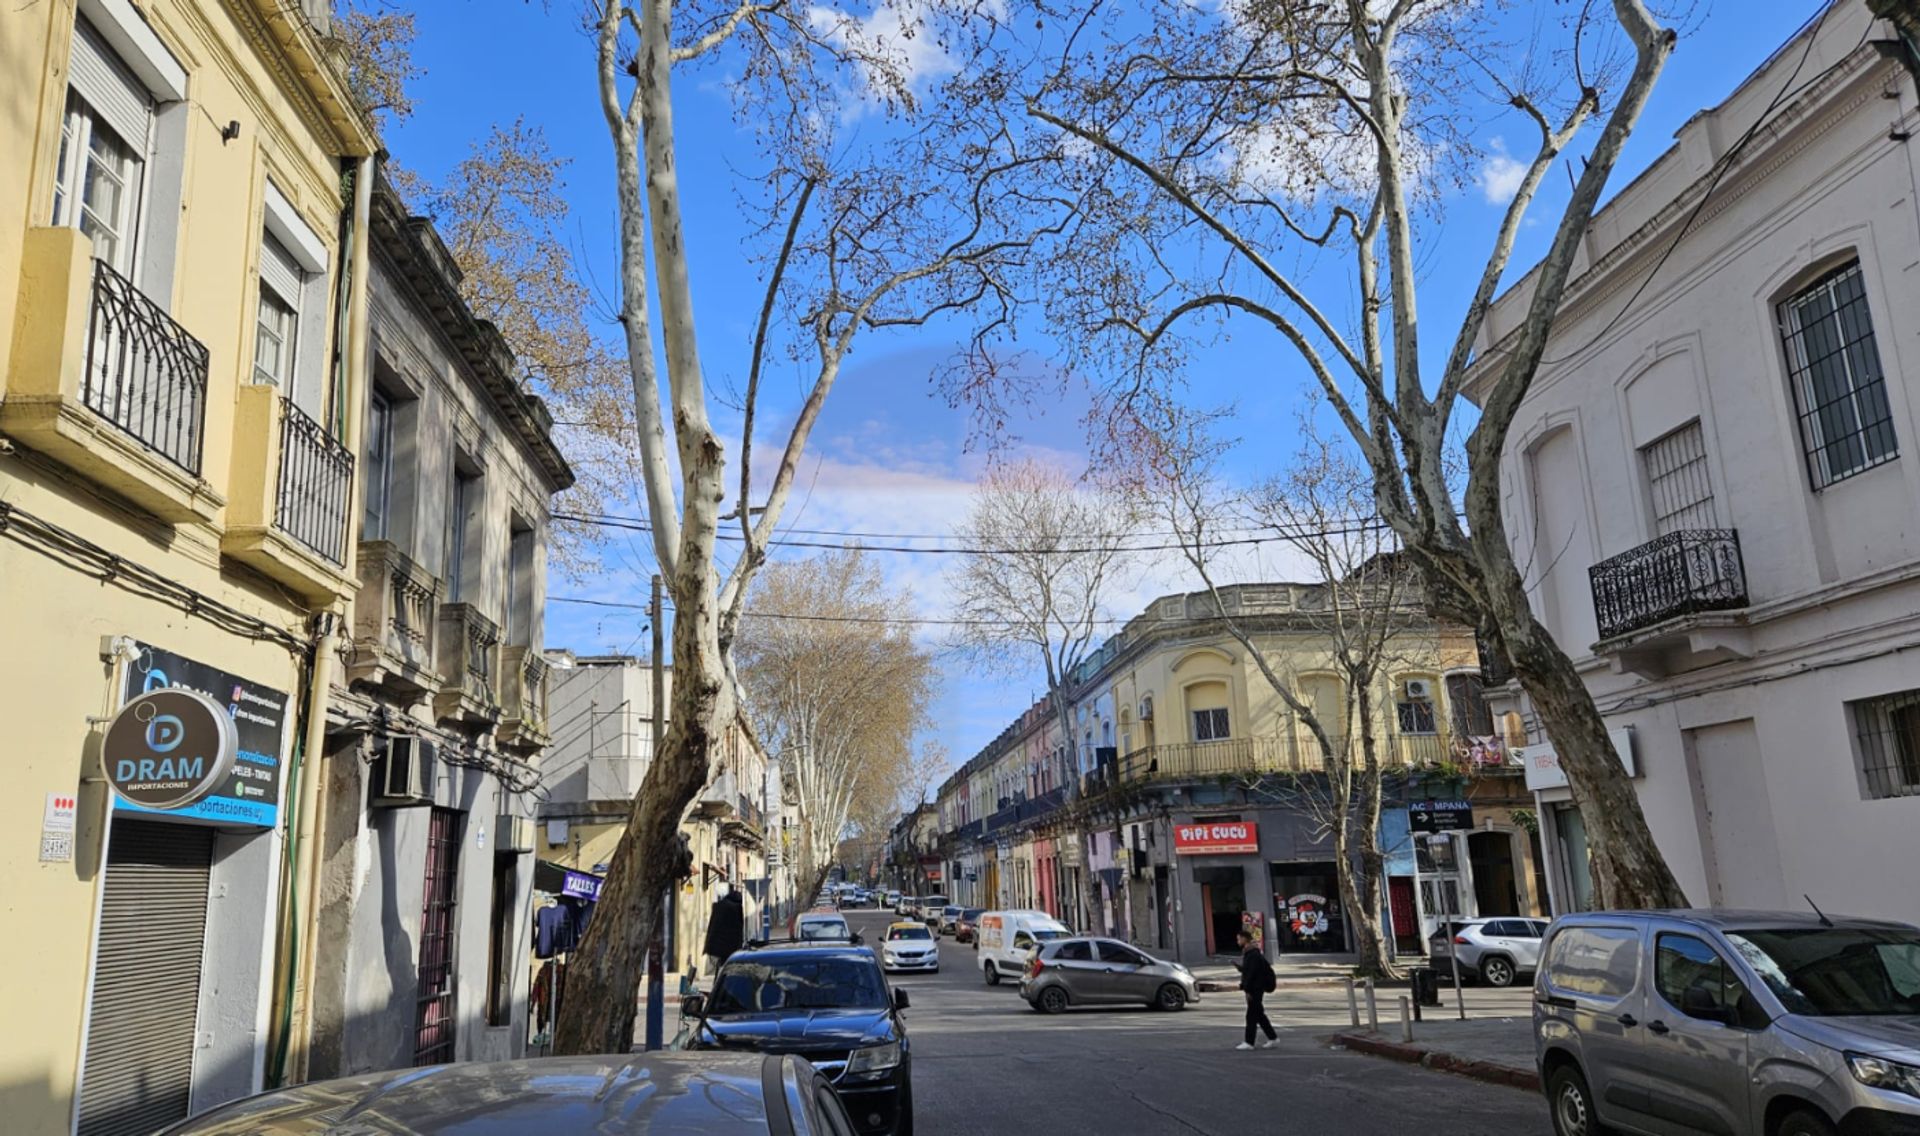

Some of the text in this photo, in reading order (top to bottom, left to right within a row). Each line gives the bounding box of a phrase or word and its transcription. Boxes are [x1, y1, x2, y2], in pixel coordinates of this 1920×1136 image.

[116, 757, 203, 782] DRAM
[127, 781, 189, 791] IMPORTACIONES
[567, 876, 595, 895] TALLES
